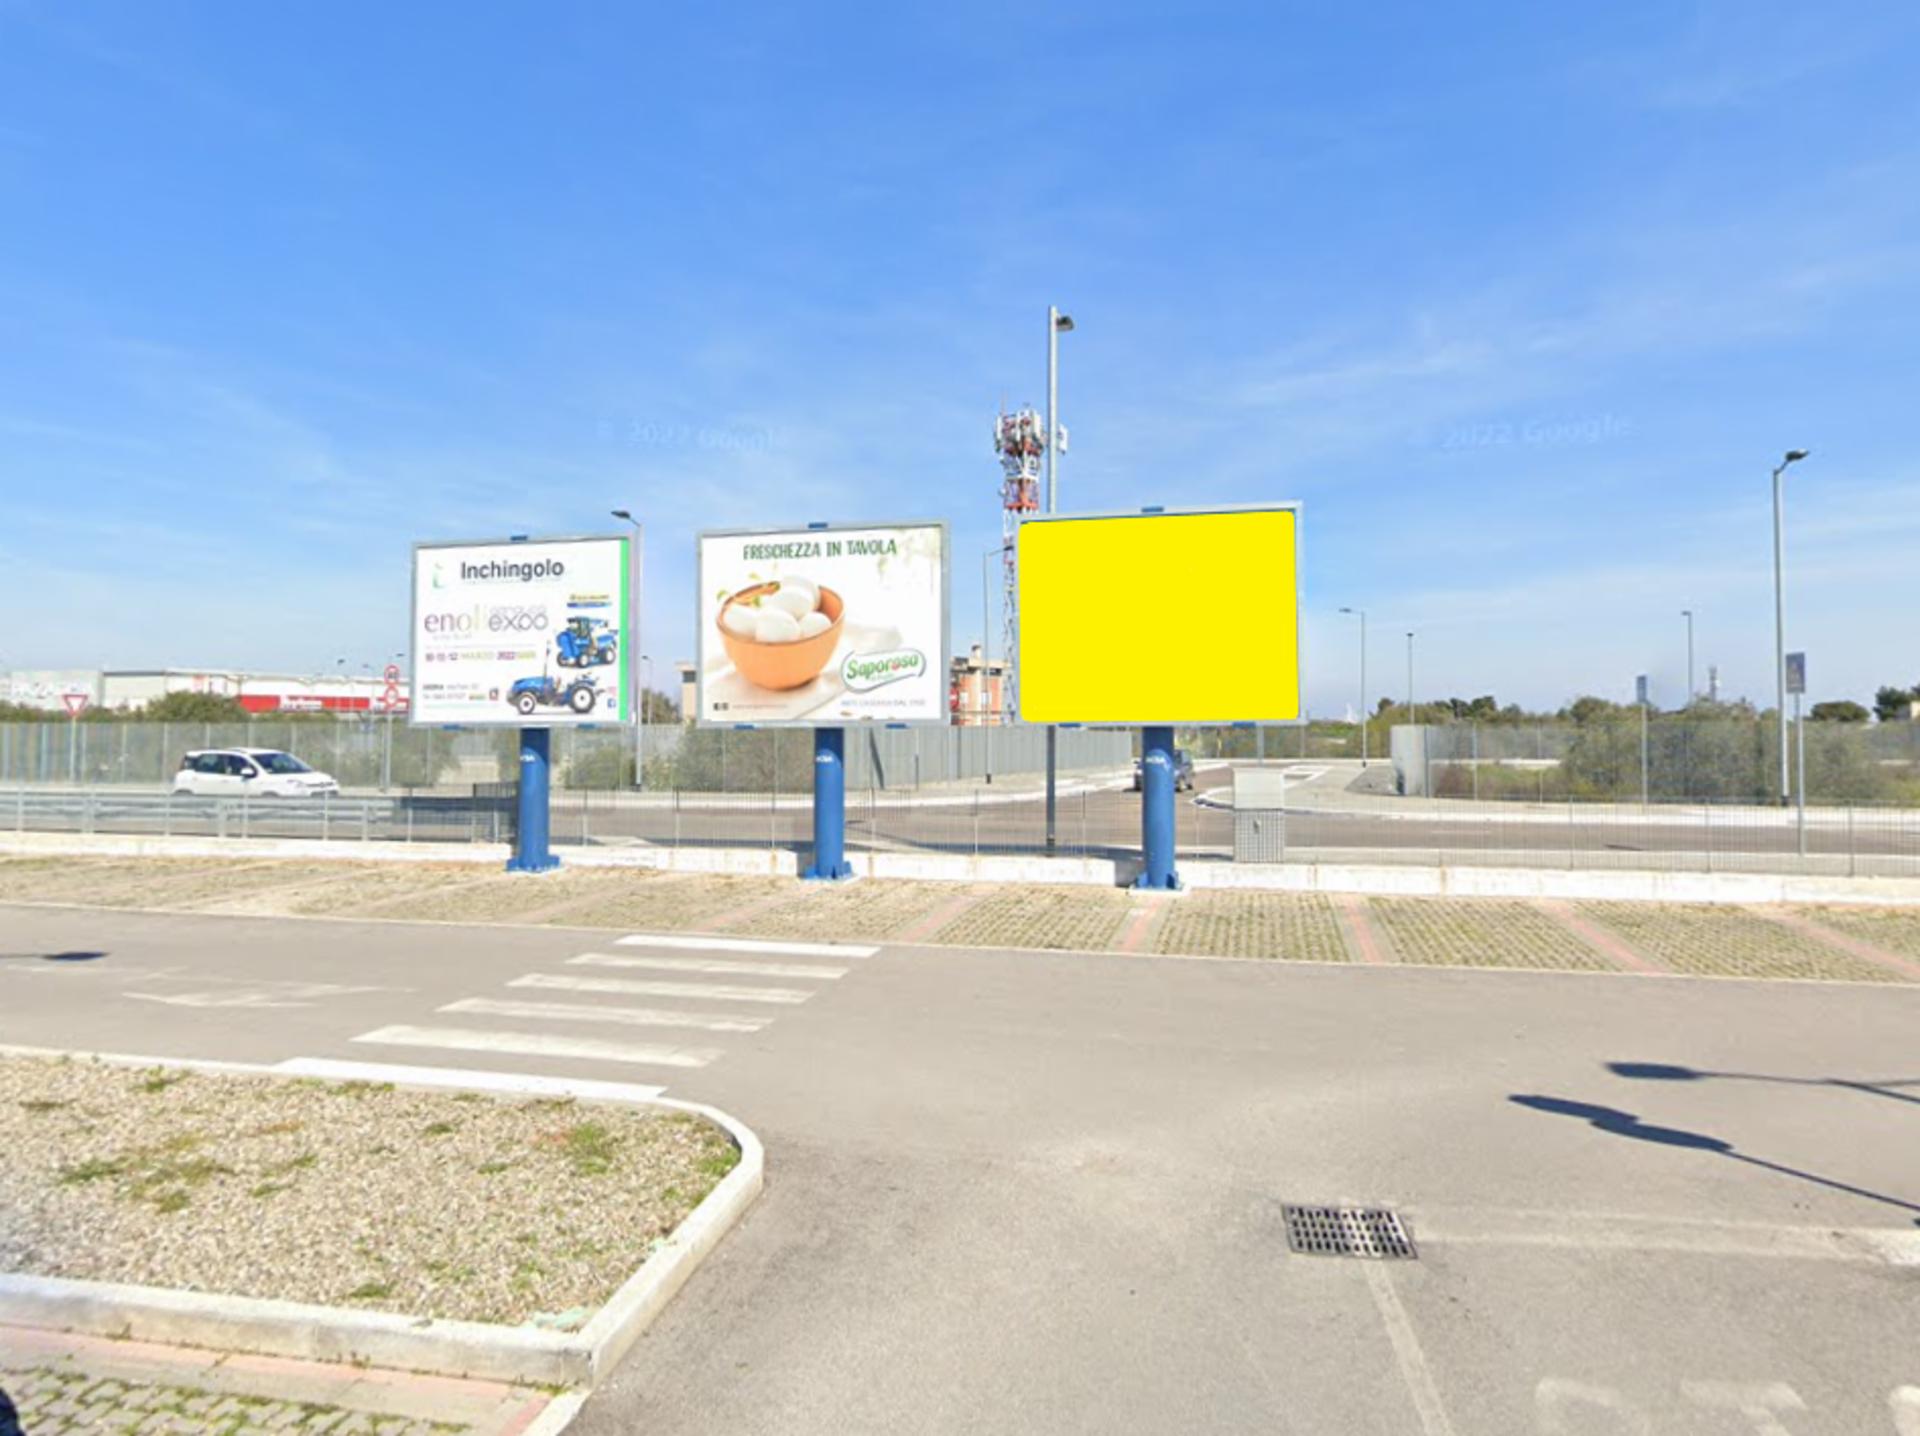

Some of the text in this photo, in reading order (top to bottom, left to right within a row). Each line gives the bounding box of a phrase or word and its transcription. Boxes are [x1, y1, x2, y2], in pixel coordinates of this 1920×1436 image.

[743, 538, 898, 560] FRESCHEZZA IN TAVOLA
[461, 559, 565, 582] Inchingolo
[846, 655, 919, 680] Saporosa
